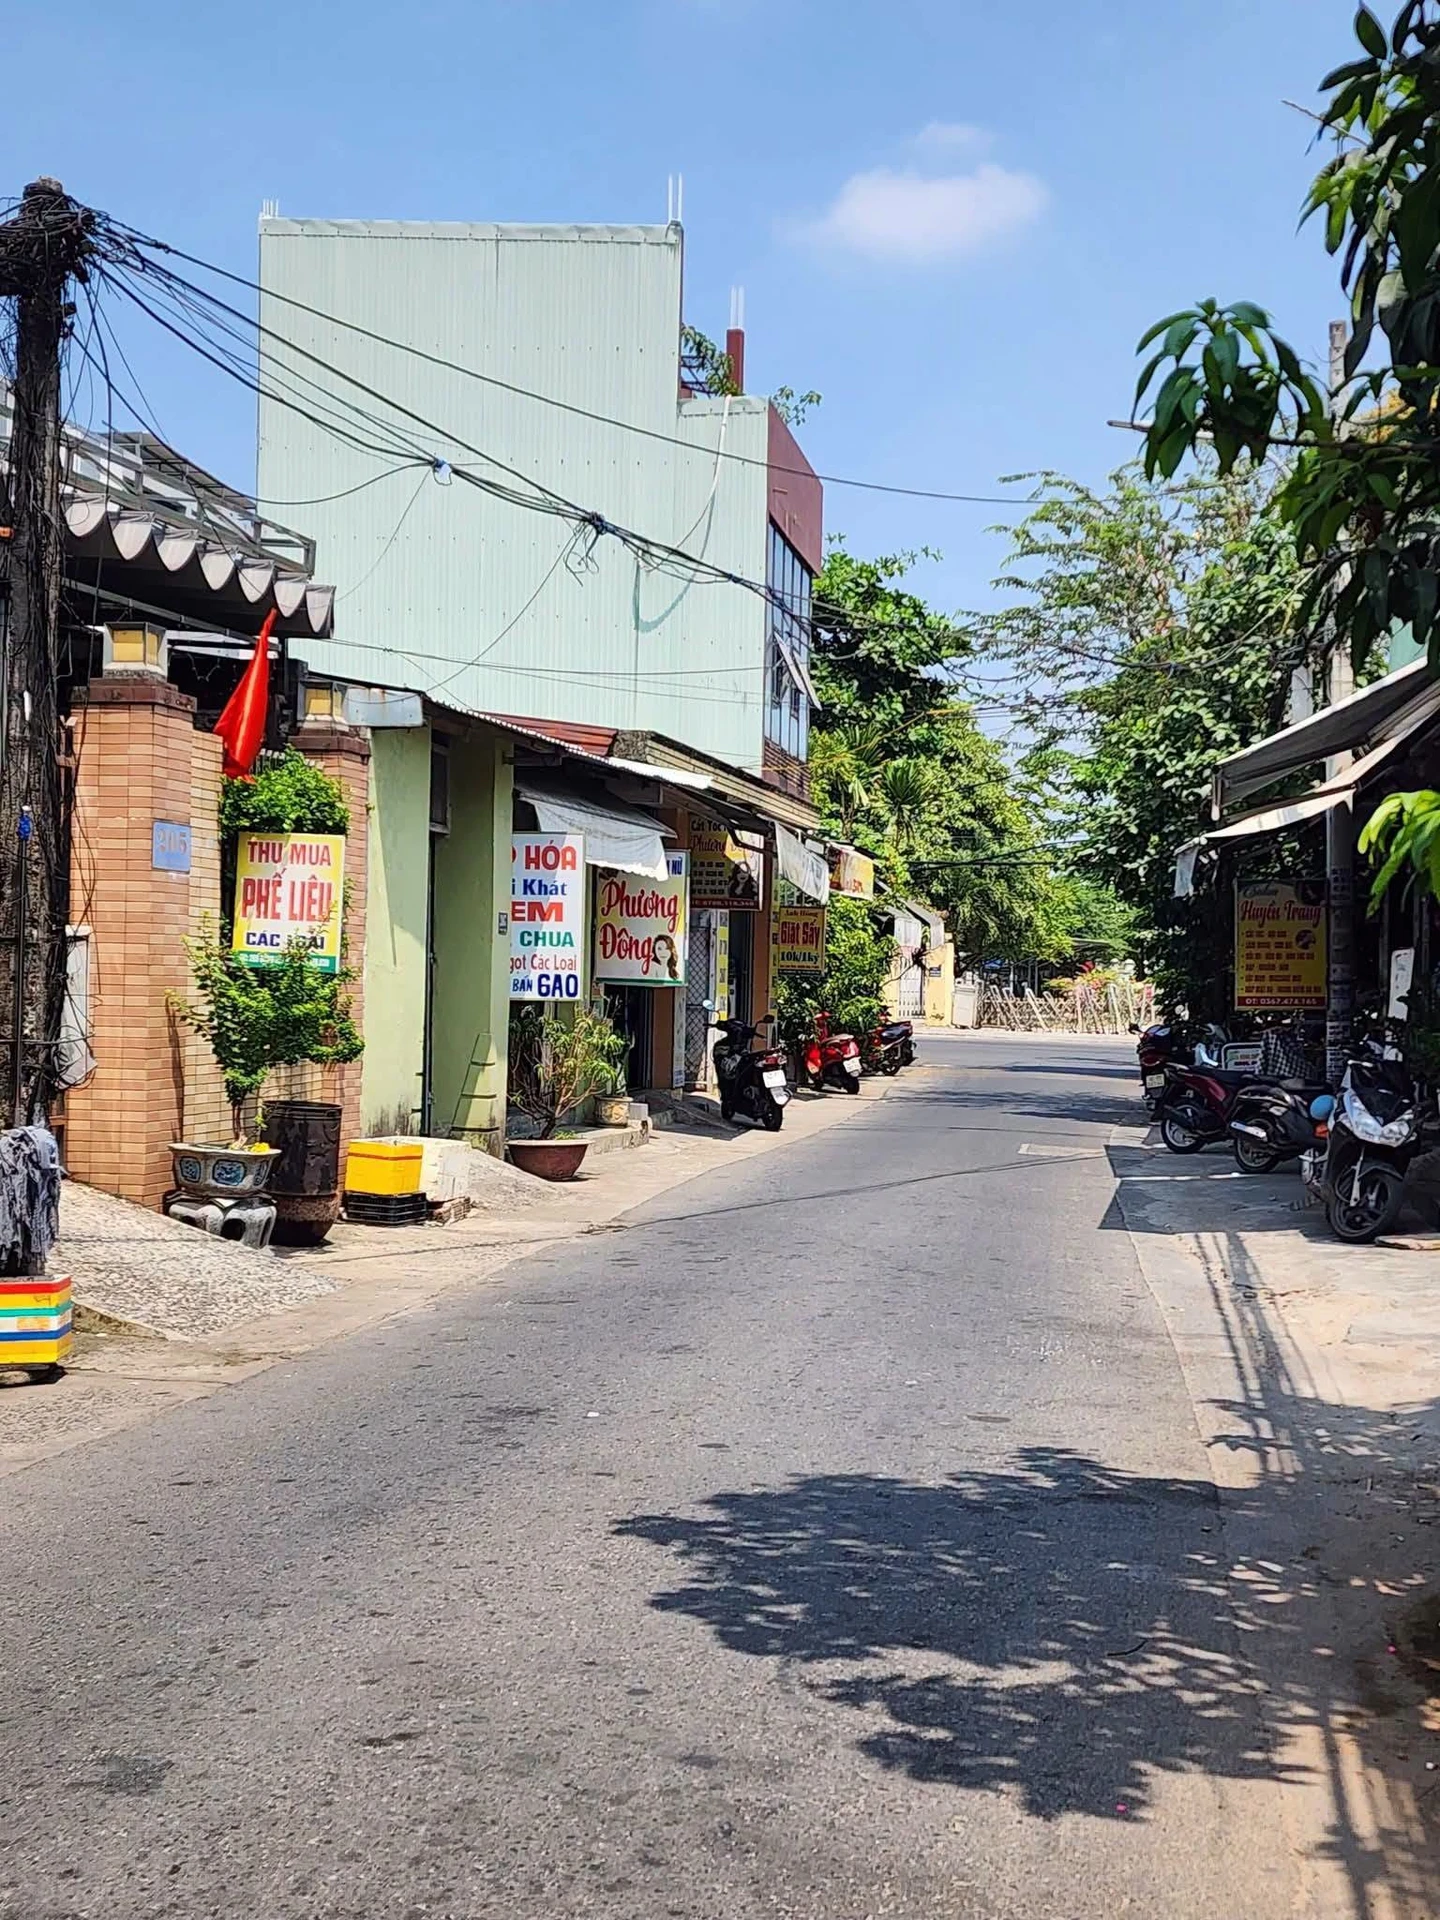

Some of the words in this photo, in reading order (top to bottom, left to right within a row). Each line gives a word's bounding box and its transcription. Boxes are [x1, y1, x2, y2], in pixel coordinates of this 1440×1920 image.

[247, 840, 283, 864] THU
[289, 842, 332, 866] MUA
[524, 840, 577, 870] HÓA
[241, 867, 286, 920] PHẾ
[522, 878, 568, 896] Khát
[601, 879, 678, 933] Phương
[1284, 900, 1322, 928] Trang
[245, 929, 281, 947] CÁC
[519, 929, 575, 948] CHUA
[802, 919, 820, 949] Sấy
[530, 954, 553, 971] Các
[599, 922, 653, 976] Đông
[512, 975, 533, 992] BÁN
